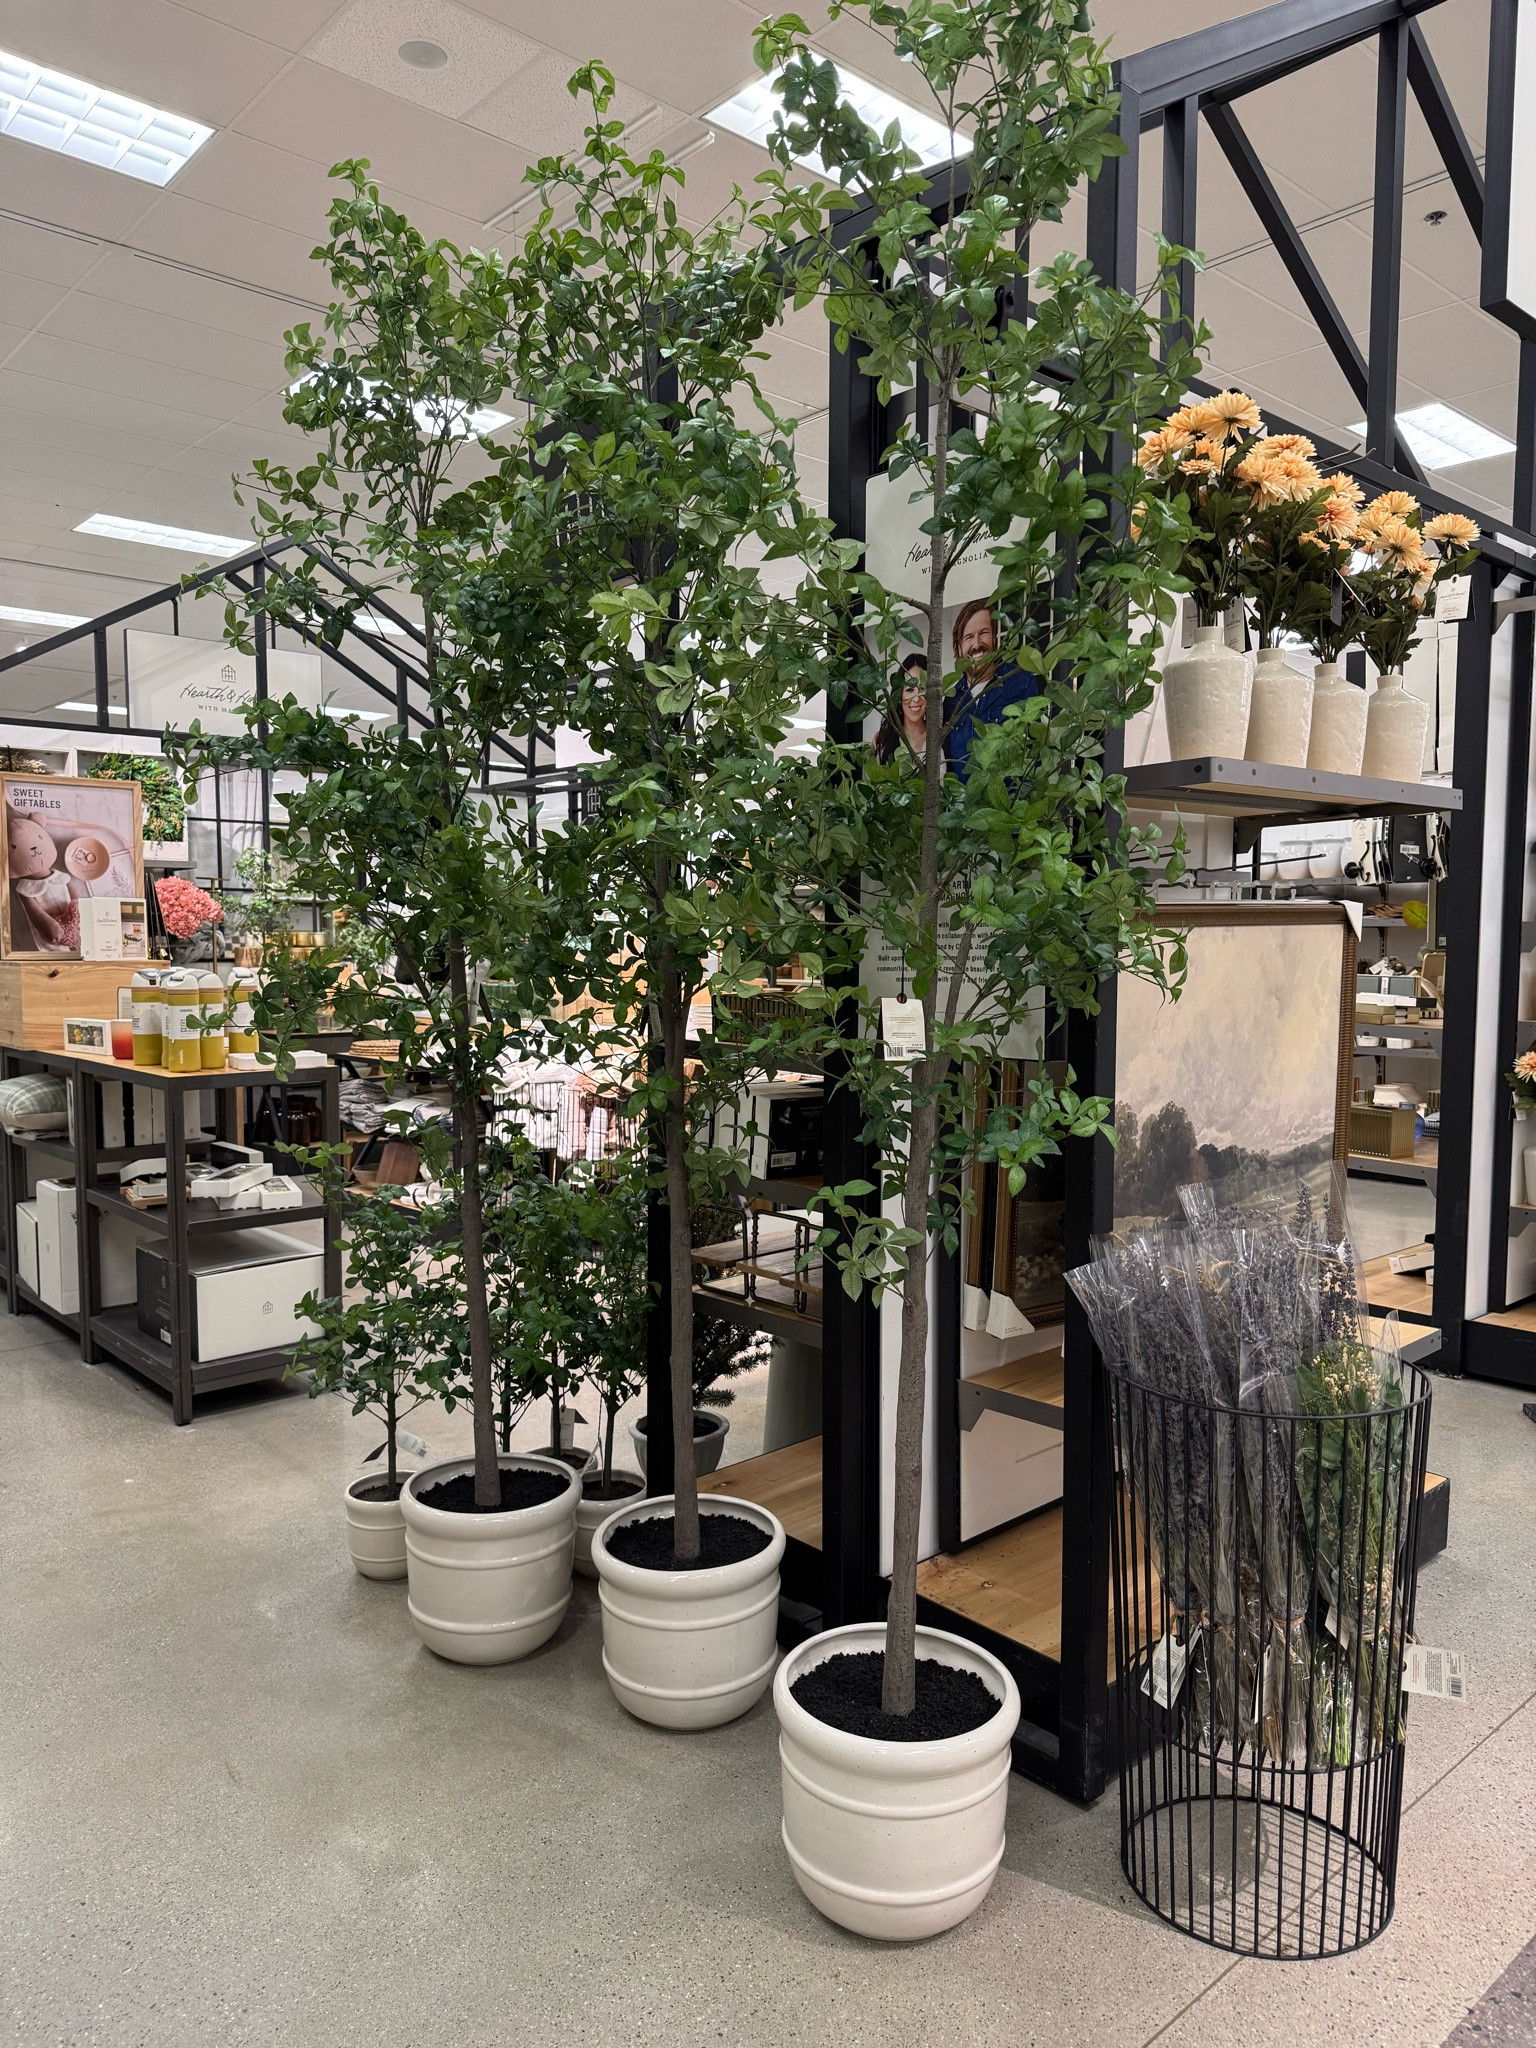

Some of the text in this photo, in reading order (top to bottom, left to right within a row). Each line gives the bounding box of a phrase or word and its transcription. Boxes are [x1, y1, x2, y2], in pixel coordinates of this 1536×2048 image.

[952, 551, 988, 567] GNOLIA
[179, 683, 230, 702] Hearth
[226, 689, 236, 703] &
[198, 704, 218, 712] WITH
[13, 788, 44, 798] SWEET
[13, 798, 61, 809] GIFTABLES
